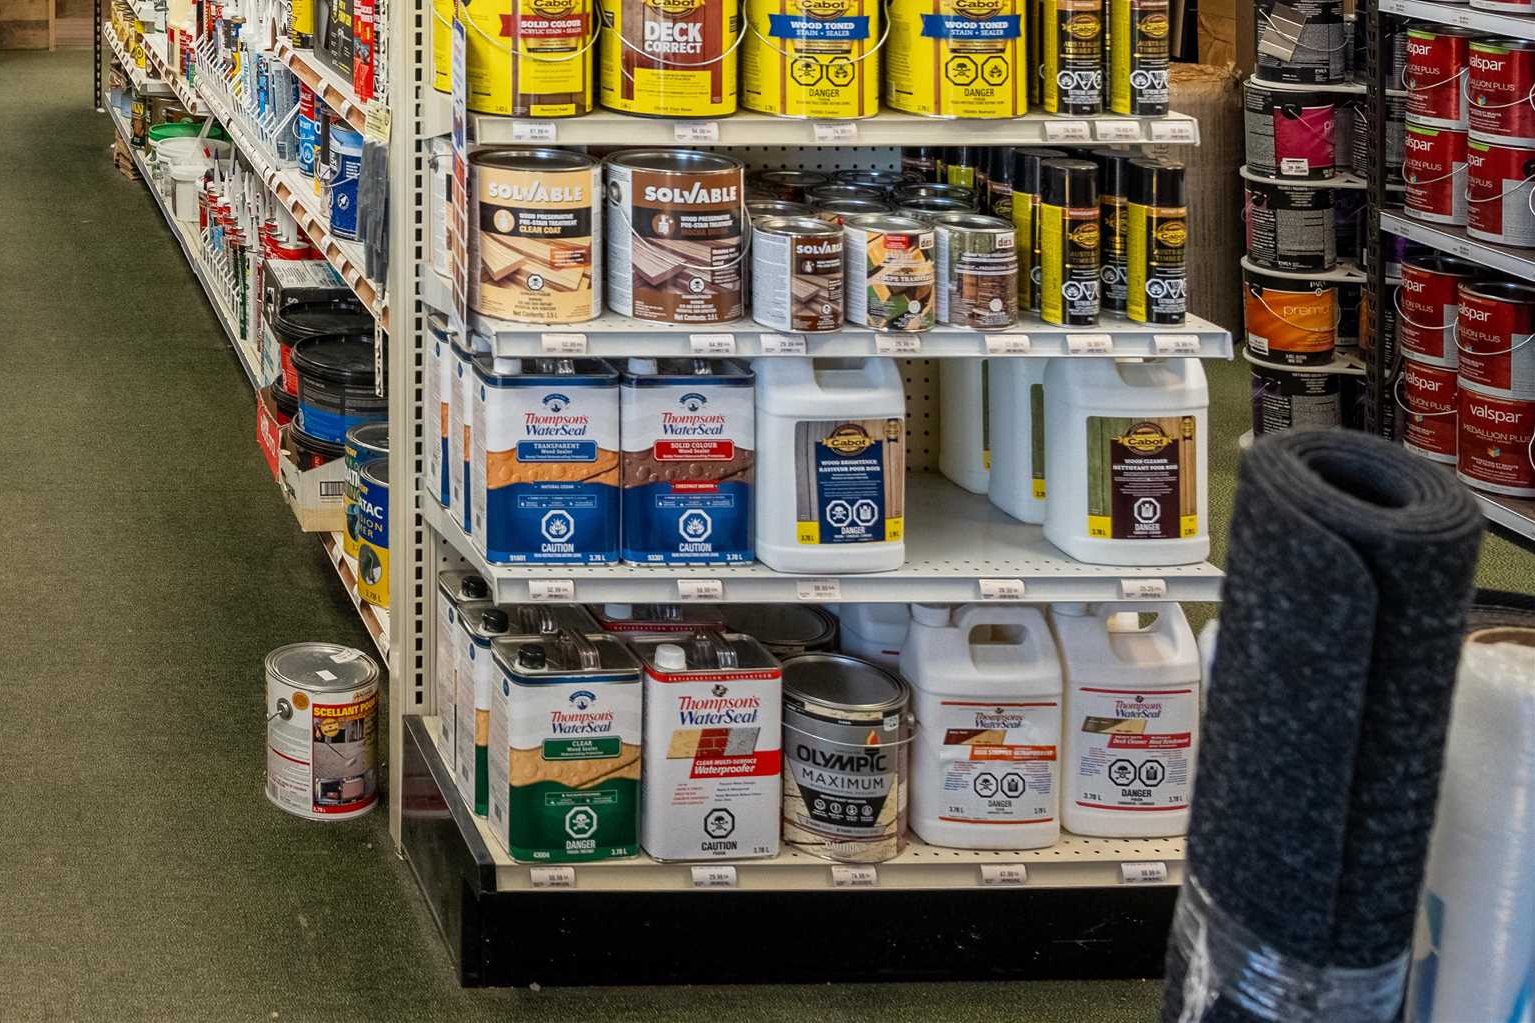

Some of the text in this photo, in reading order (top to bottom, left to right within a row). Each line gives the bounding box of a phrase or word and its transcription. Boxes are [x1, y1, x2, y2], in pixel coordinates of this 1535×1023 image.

[804, 0, 845, 9] Cabot
[955, 0, 998, 9] Cabot
[520, 19, 581, 28] SOLID COLOUR
[791, 21, 855, 30] WOOD TONED
[945, 21, 1008, 30] WOOD TONED
[645, 21, 703, 42] DECK
[645, 41, 703, 54] CORRECT
[809, 88, 840, 97] DANGER
[964, 88, 994, 97] DANGER
[488, 181, 583, 203] SOLVABLE
[644, 181, 737, 204] SOLVABLE
[796, 241, 843, 255] SOLVABLE
[525, 412, 589, 426] Thompson's
[662, 412, 726, 426] Thompson's
[1469, 403, 1523, 425] valspar
[526, 424, 587, 436] WaterSeal
[663, 424, 724, 436] WaterSeal
[831, 437, 866, 447] Cabot
[1126, 437, 1164, 447] Cabot
[841, 526, 866, 535] DANGER
[1134, 523, 1160, 531] DANGER
[541, 543, 574, 553] CAUTION
[679, 543, 712, 553] CAUTION
[669, 672, 773, 682] SATISFACTION GUARANTEED
[678, 696, 761, 712] Thompson's
[1114, 699, 1162, 712] Thompson's
[313, 705, 355, 719] SCELLANT
[550, 710, 614, 724] Thompson's
[679, 708, 758, 726] WaterSeal
[975, 711, 1024, 724] Thompson's
[1115, 708, 1162, 720] WaterSeal
[552, 721, 612, 734] WaterSeal
[975, 719, 1024, 730] WaterSeal
[572, 740, 592, 748] CLEAR
[797, 744, 888, 774] OLYMPIC
[694, 764, 756, 776] Waterproofer
[802, 769, 885, 790] MAXIMUM
[1121, 788, 1152, 798] DANGER
[988, 800, 1013, 808] DANGER
[566, 840, 596, 850] DANGER
[701, 840, 738, 852] CAUTION
